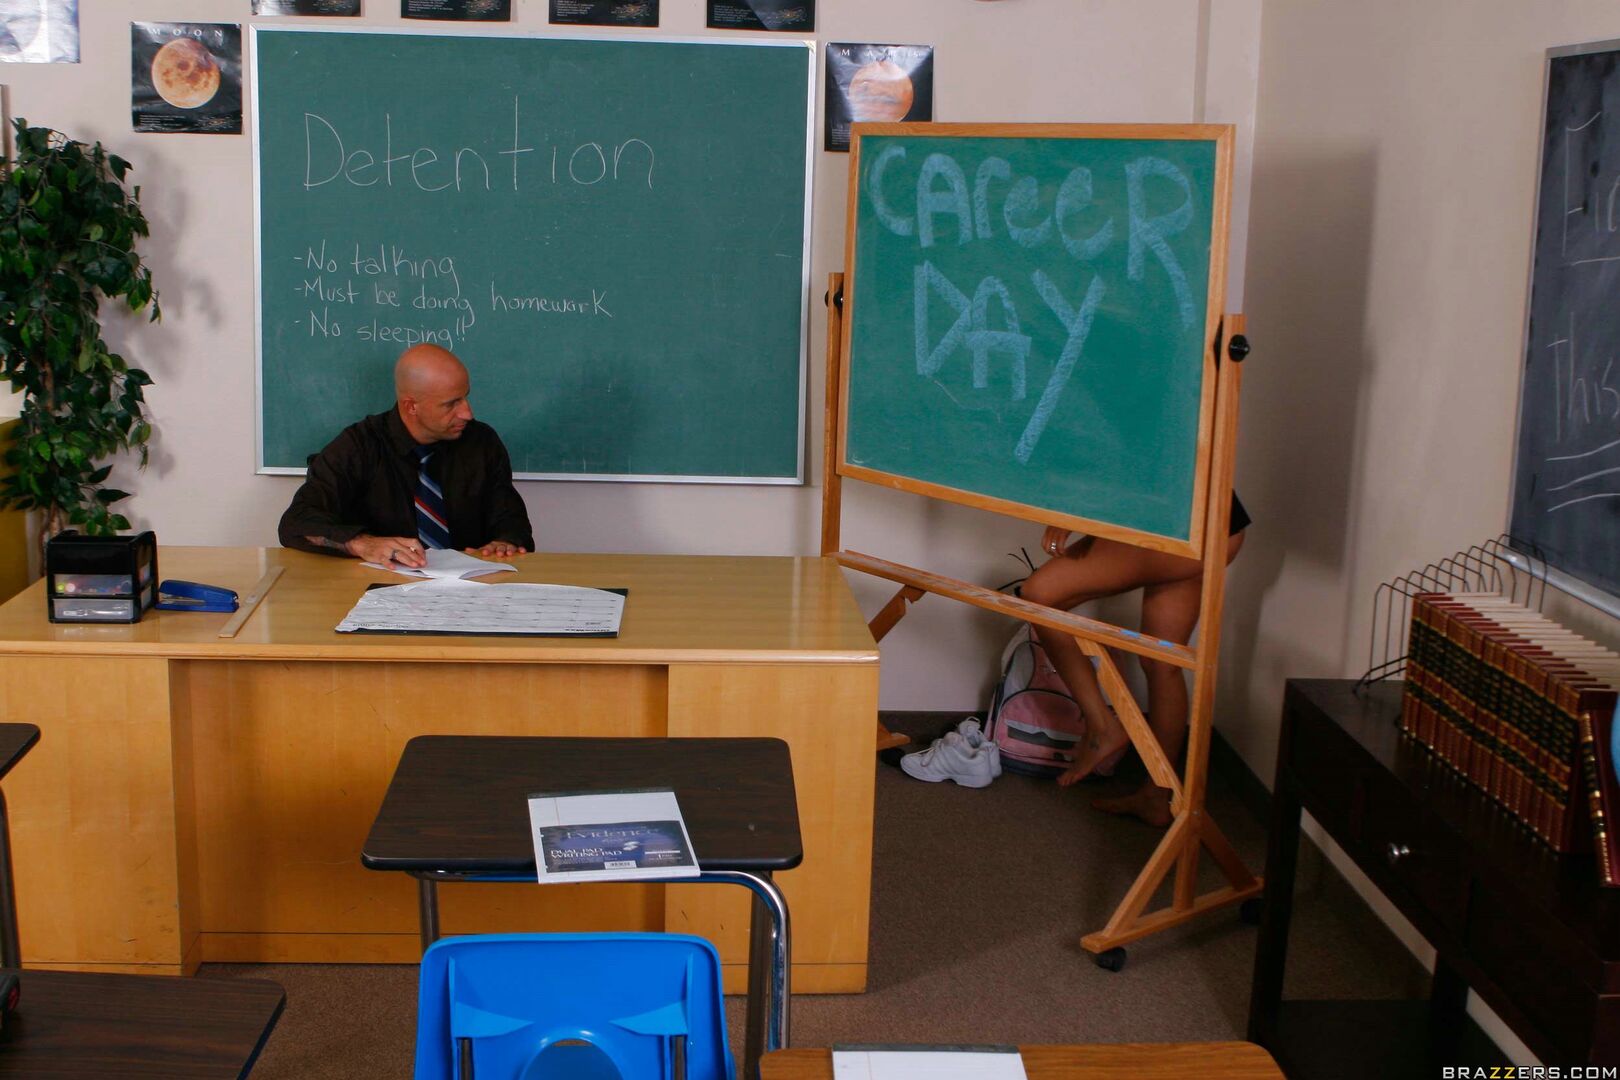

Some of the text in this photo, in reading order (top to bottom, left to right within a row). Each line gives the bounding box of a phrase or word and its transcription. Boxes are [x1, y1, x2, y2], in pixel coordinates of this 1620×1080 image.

[147, 28, 224, 38] MOON
[303, 95, 654, 192] Detention
[350, 242, 460, 299] talking
[374, 281, 400, 307] be
[411, 283, 475, 328] doing
[601, 849, 624, 857] PAD
